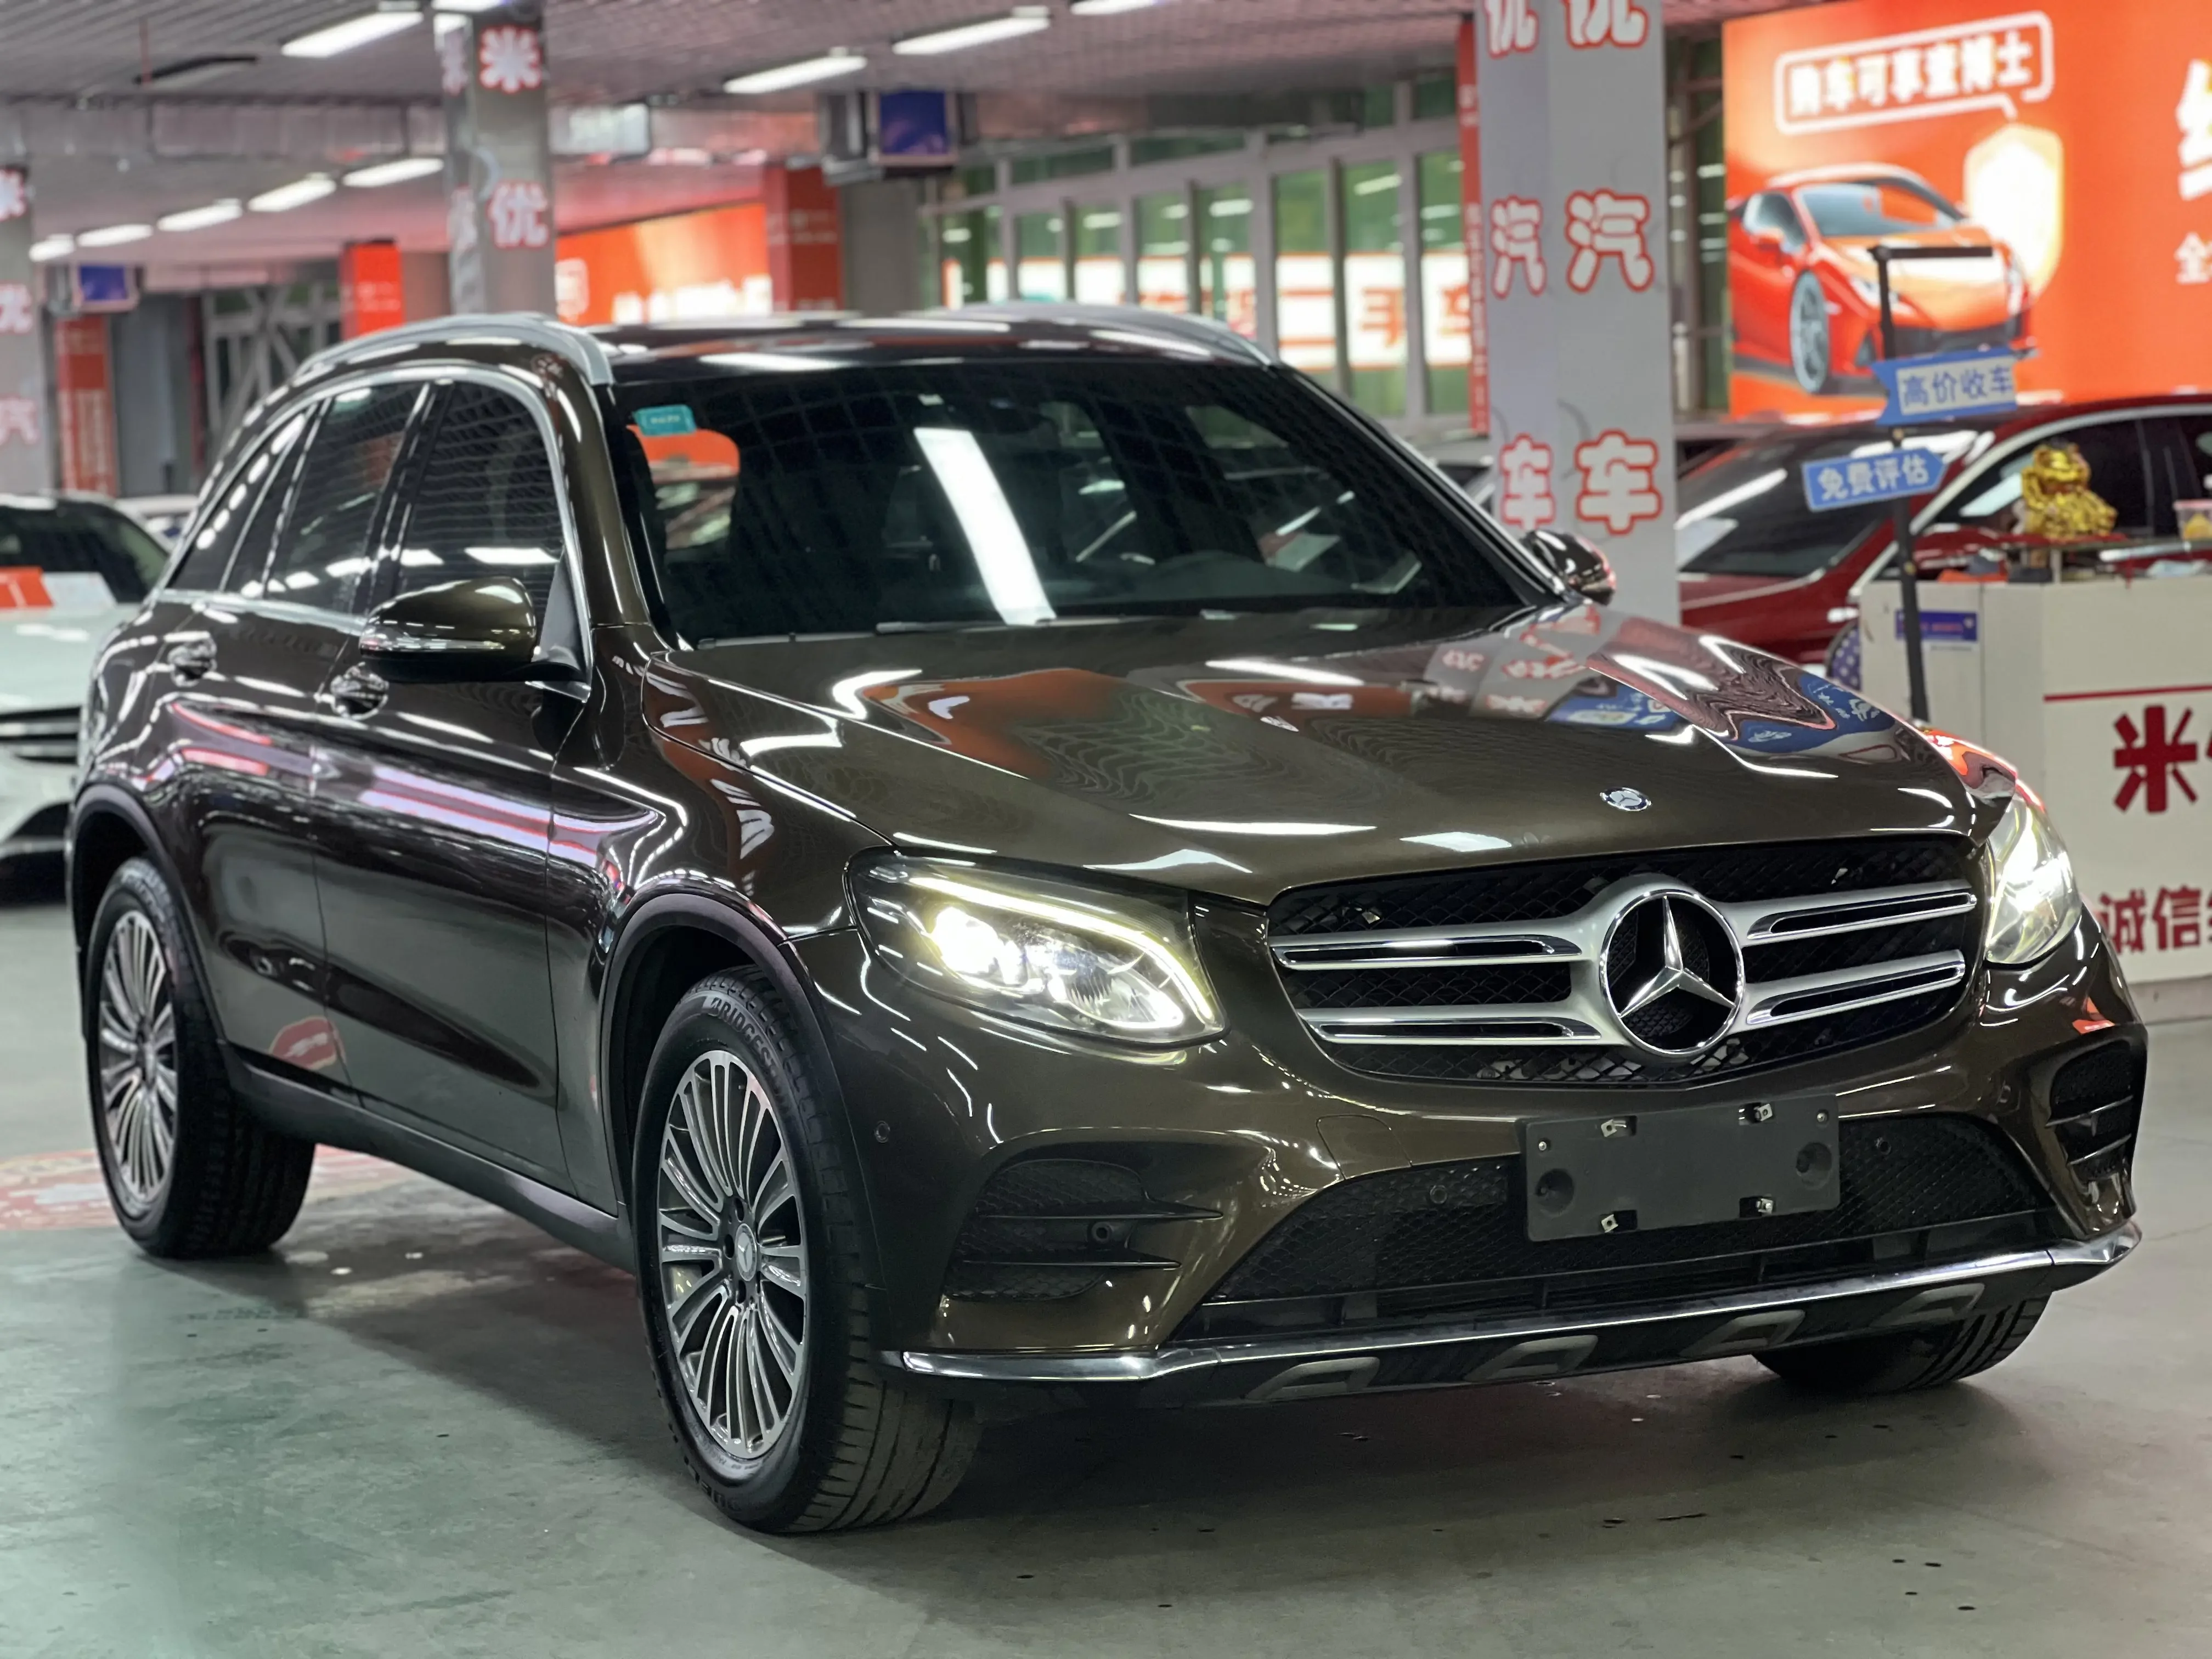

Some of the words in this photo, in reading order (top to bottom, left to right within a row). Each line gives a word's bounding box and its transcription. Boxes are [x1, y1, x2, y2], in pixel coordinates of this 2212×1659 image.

[1902, 364, 2014, 407] 高价收车
[1817, 454, 1929, 501] 免费评估
[2113, 704, 2212, 813] 米
[2097, 884, 2212, 956] 诚信
